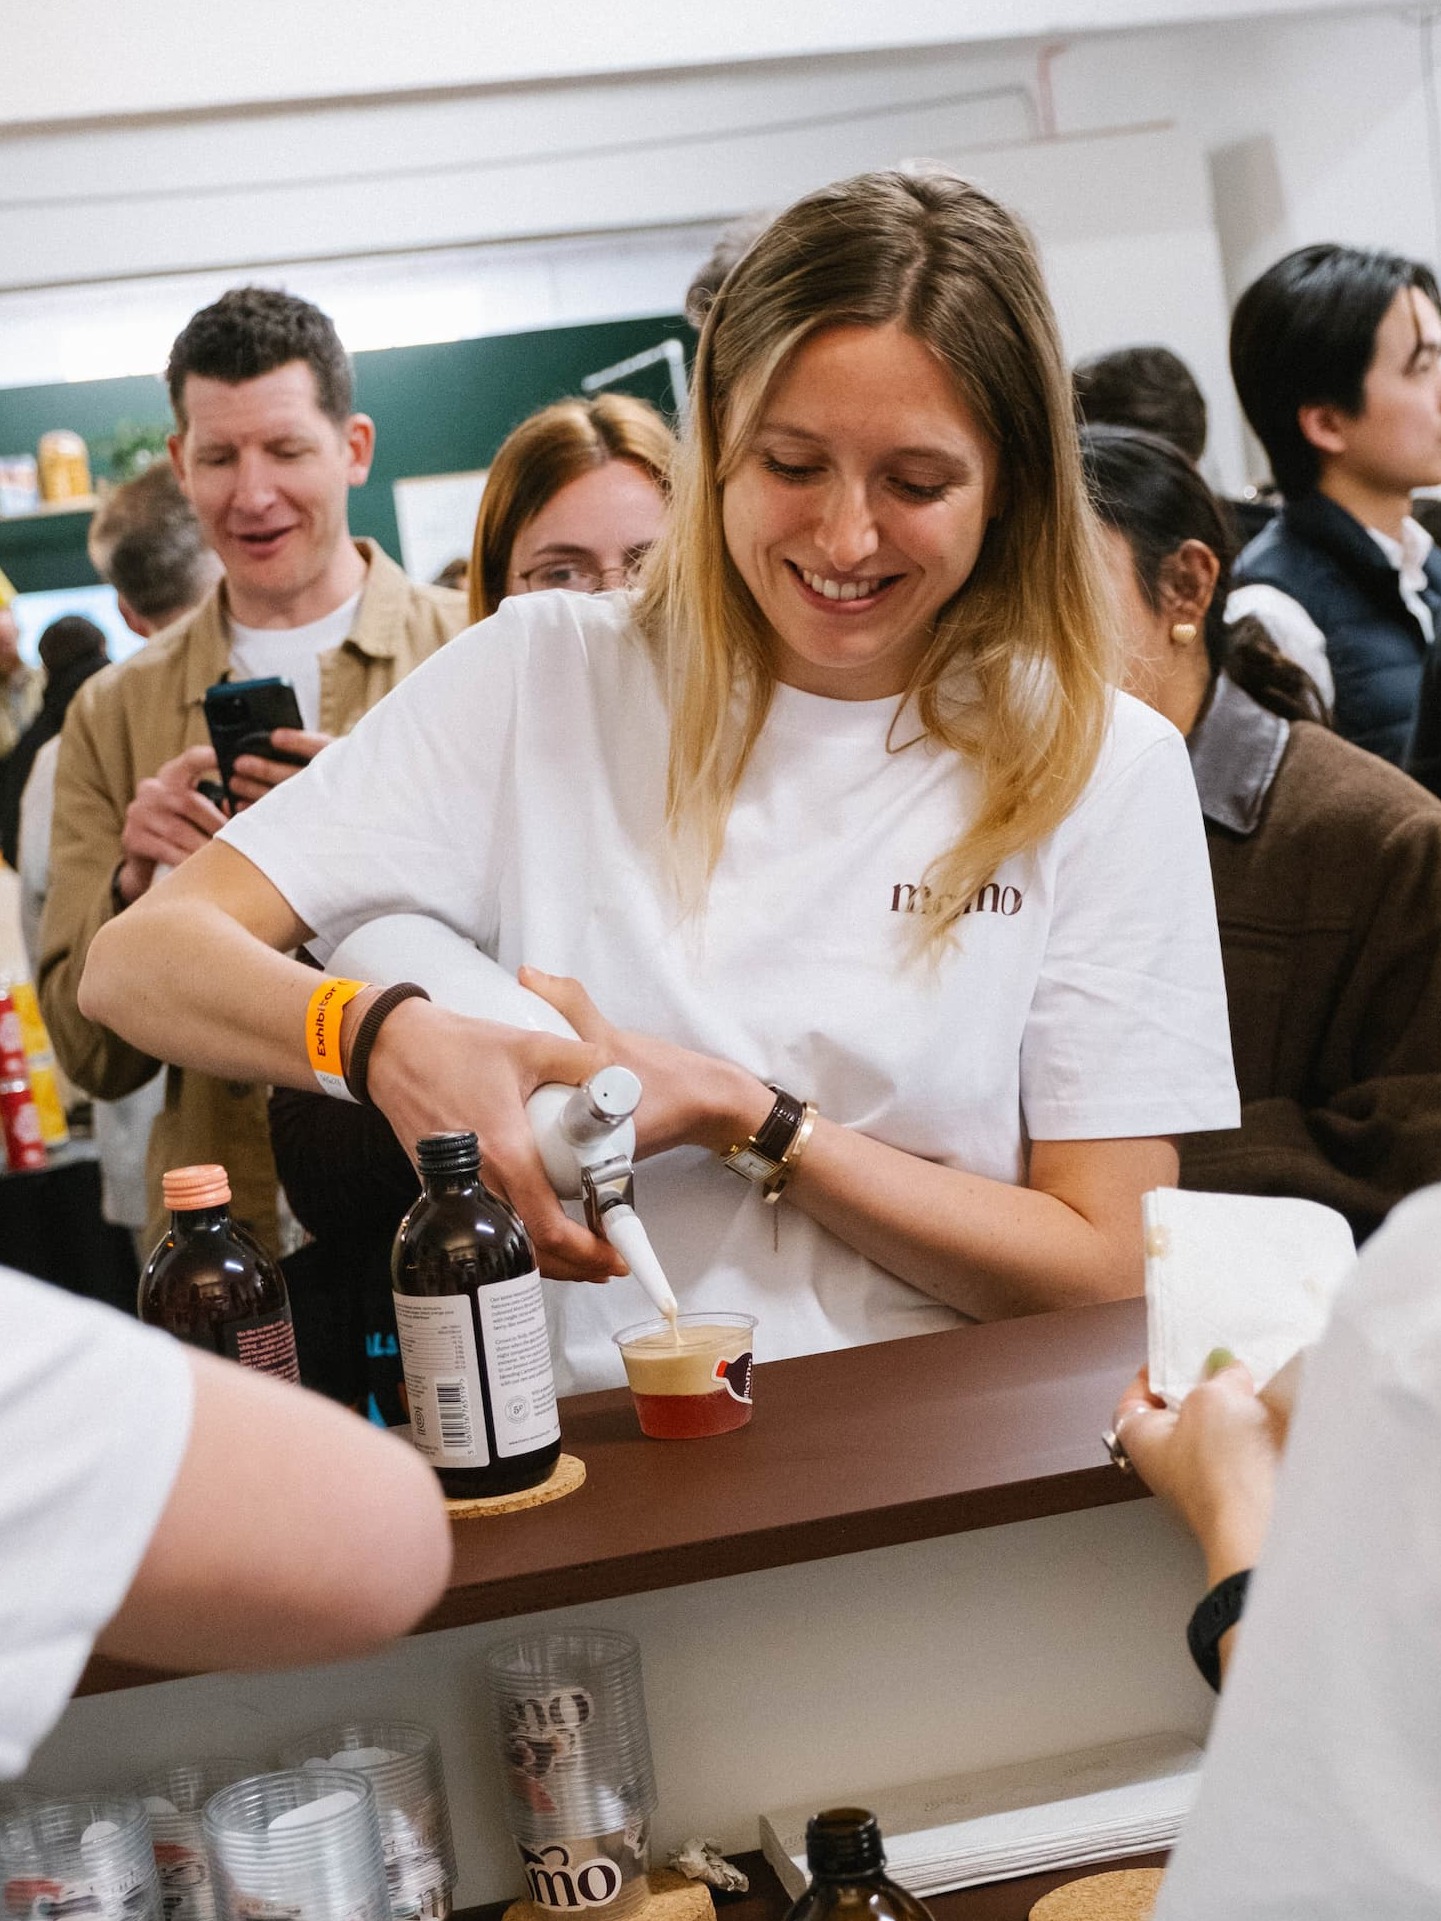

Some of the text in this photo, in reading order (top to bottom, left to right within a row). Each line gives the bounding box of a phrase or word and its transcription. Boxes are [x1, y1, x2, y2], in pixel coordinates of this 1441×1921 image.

[890, 882, 1023, 916] mmo
[315, 986, 337, 1057] Exhibitor
[526, 1864, 617, 1907] mo
